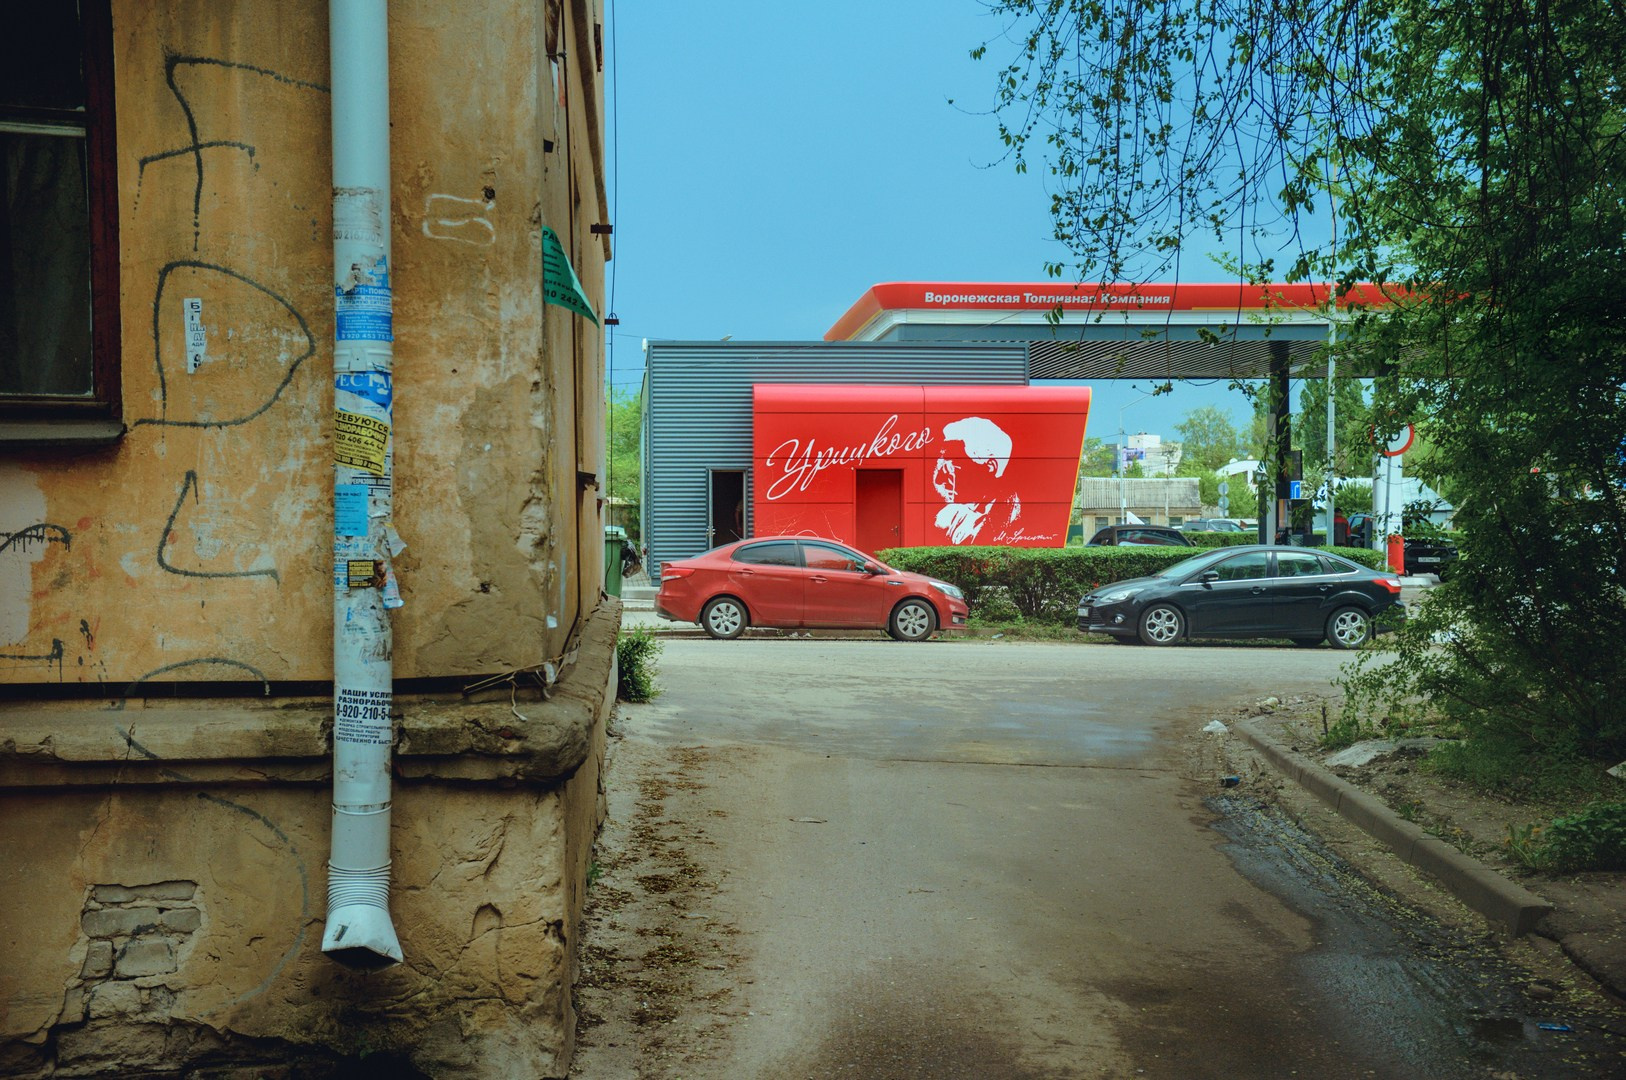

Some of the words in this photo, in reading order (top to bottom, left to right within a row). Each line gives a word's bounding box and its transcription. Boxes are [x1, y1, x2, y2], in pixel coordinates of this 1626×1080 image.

[561, 293, 578, 306] 242
[924, 292, 1020, 304] Воронежская
[1024, 292, 1096, 304] Топливная
[1100, 292, 1170, 304] Компания
[348, 435, 362, 444] 406
[766, 414, 934, 500] Урицкого
[342, 688, 368, 698] НАШИ
